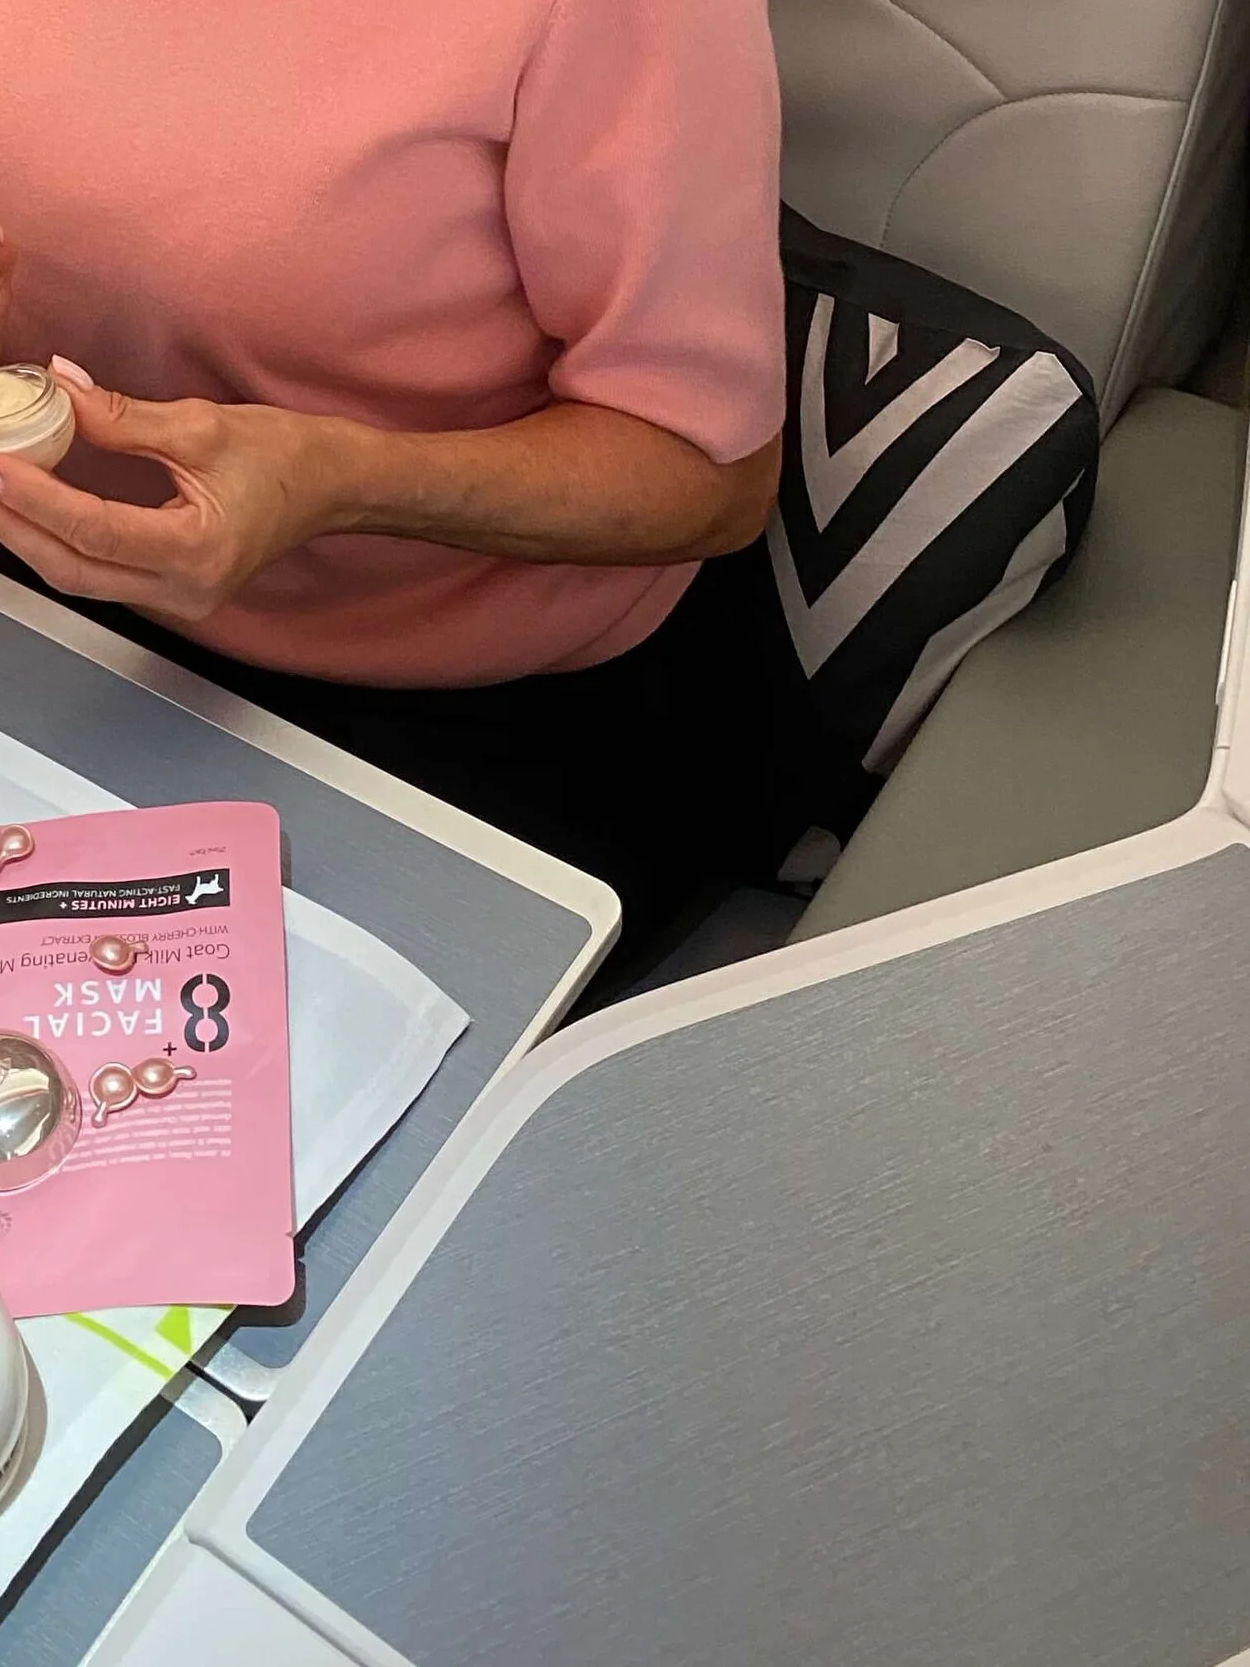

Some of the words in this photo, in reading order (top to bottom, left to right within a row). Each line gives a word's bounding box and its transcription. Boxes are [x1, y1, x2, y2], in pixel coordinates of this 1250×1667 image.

[5, 889, 69, 903] INGREDIENTS
[70, 887, 116, 898] NATURAL
[117, 882, 180, 897] FAST-ACTING
[70, 897, 135, 911] MINUTES
[138, 893, 180, 907] EIGHT
[151, 927, 196, 941] CHERRY
[198, 924, 228, 935] WITH
[40, 933, 91, 945] EXTRACT
[143, 947, 181, 965] Milk
[185, 941, 230, 961] Goat
[53, 976, 162, 1007] MASK
[22, 1007, 163, 1039] FACIAL
